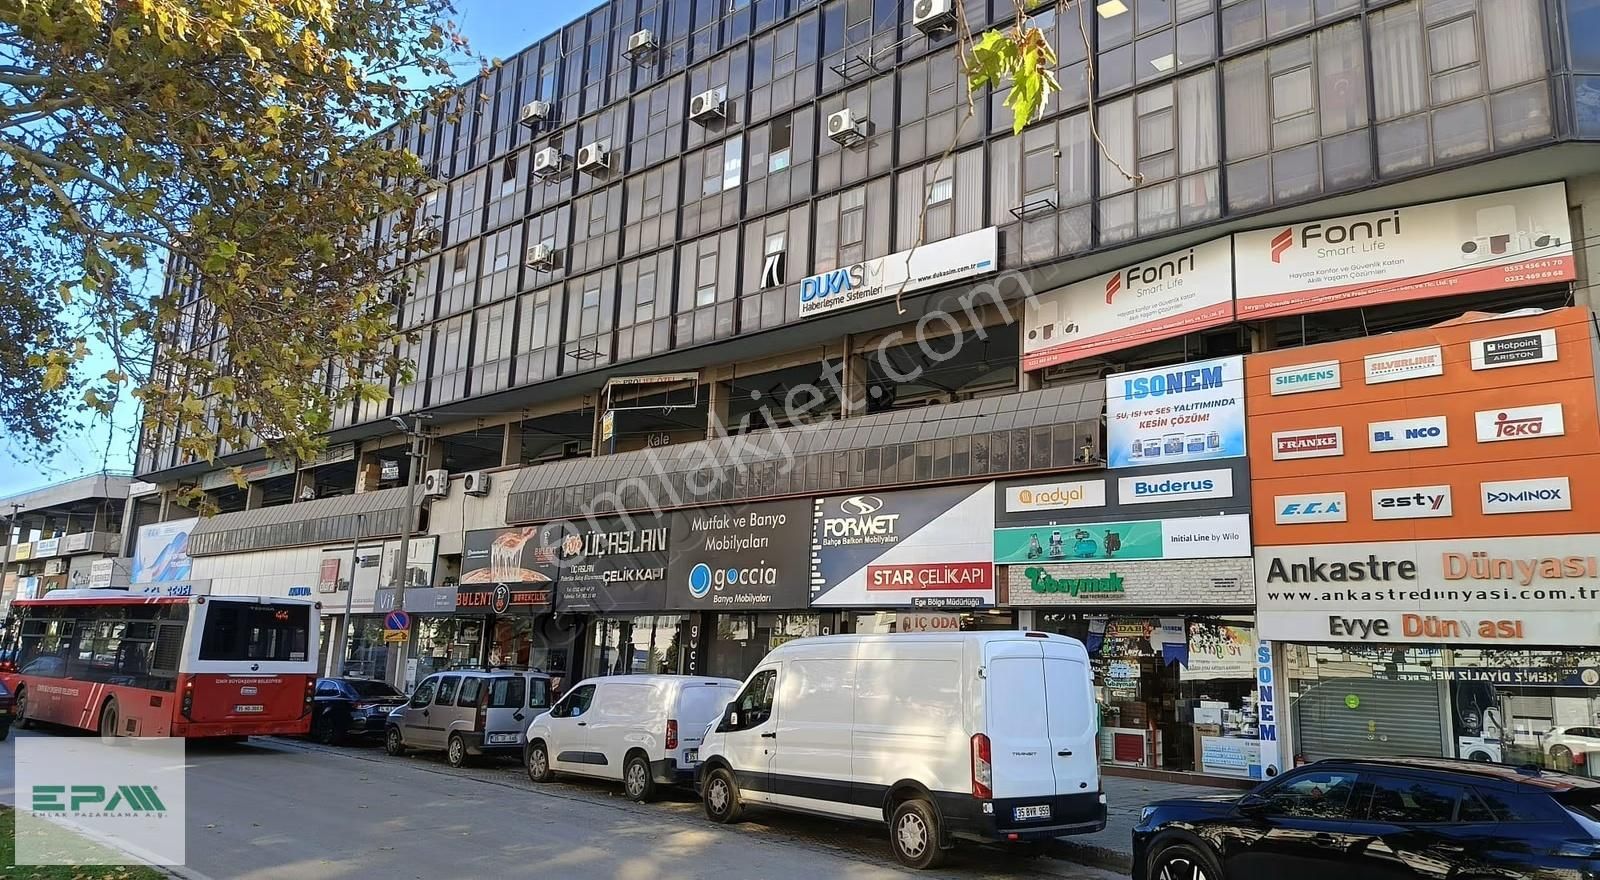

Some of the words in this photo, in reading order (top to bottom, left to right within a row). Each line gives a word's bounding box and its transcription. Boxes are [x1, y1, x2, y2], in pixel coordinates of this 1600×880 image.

[1301, 210, 1400, 248] Fonri
[1317, 245, 1356, 259] Smart
[1362, 240, 1386, 253] Life
[917, 262, 977, 283] www.dukasim.com.tr
[1126, 249, 1194, 290] Fonri
[1136, 285, 1164, 298] Smart
[1167, 278, 1184, 291] Life
[802, 294, 846, 313] Haberleşme
[846, 283, 883, 302] Sistemleri
[1497, 338, 1539, 351] Hotpoint
[1371, 355, 1435, 371] SILVERLINE
[1493, 351, 1535, 362] ARISTON
[1124, 366, 1223, 401] ISONEM
[1275, 369, 1335, 386] SIEMENS
[1155, 406, 1171, 414] SES
[1173, 397, 1236, 413] YALITIMINDA
[1139, 417, 1168, 429] KESİN
[1170, 413, 1210, 427] ÇÖZÜM!
[647, 432, 671, 447] Kale
[1278, 434, 1338, 451] FRANKE
[1035, 485, 1083, 506] radyal
[1134, 479, 1214, 495] Buderus
[1487, 488, 1561, 504] DOMINOX
[691, 514, 730, 531] Mutfak
[732, 517, 746, 528] ve
[749, 512, 786, 529] Banyo
[823, 513, 900, 538] FORMET
[704, 533, 769, 553] Mobilyaları
[1171, 534, 1193, 543] Initial
[1193, 533, 1210, 542] Line
[1211, 533, 1221, 543] by
[1222, 532, 1240, 542] Wilo
[602, 566, 634, 587] ÇELİK
[635, 567, 665, 581] KAPI
[714, 559, 777, 591] goccia
[873, 569, 914, 585] STAR
[1266, 554, 1417, 583] Ankastre
[1441, 551, 1599, 587] Dünyası
[1045, 572, 1125, 597] baymak
[713, 594, 734, 605] Banyo
[914, 598, 927, 608] Ege
[927, 597, 946, 607] Bölge
[931, 617, 960, 629] ODA
[1328, 615, 1390, 640] Evye
[1257, 640, 1277, 741] SONEM
